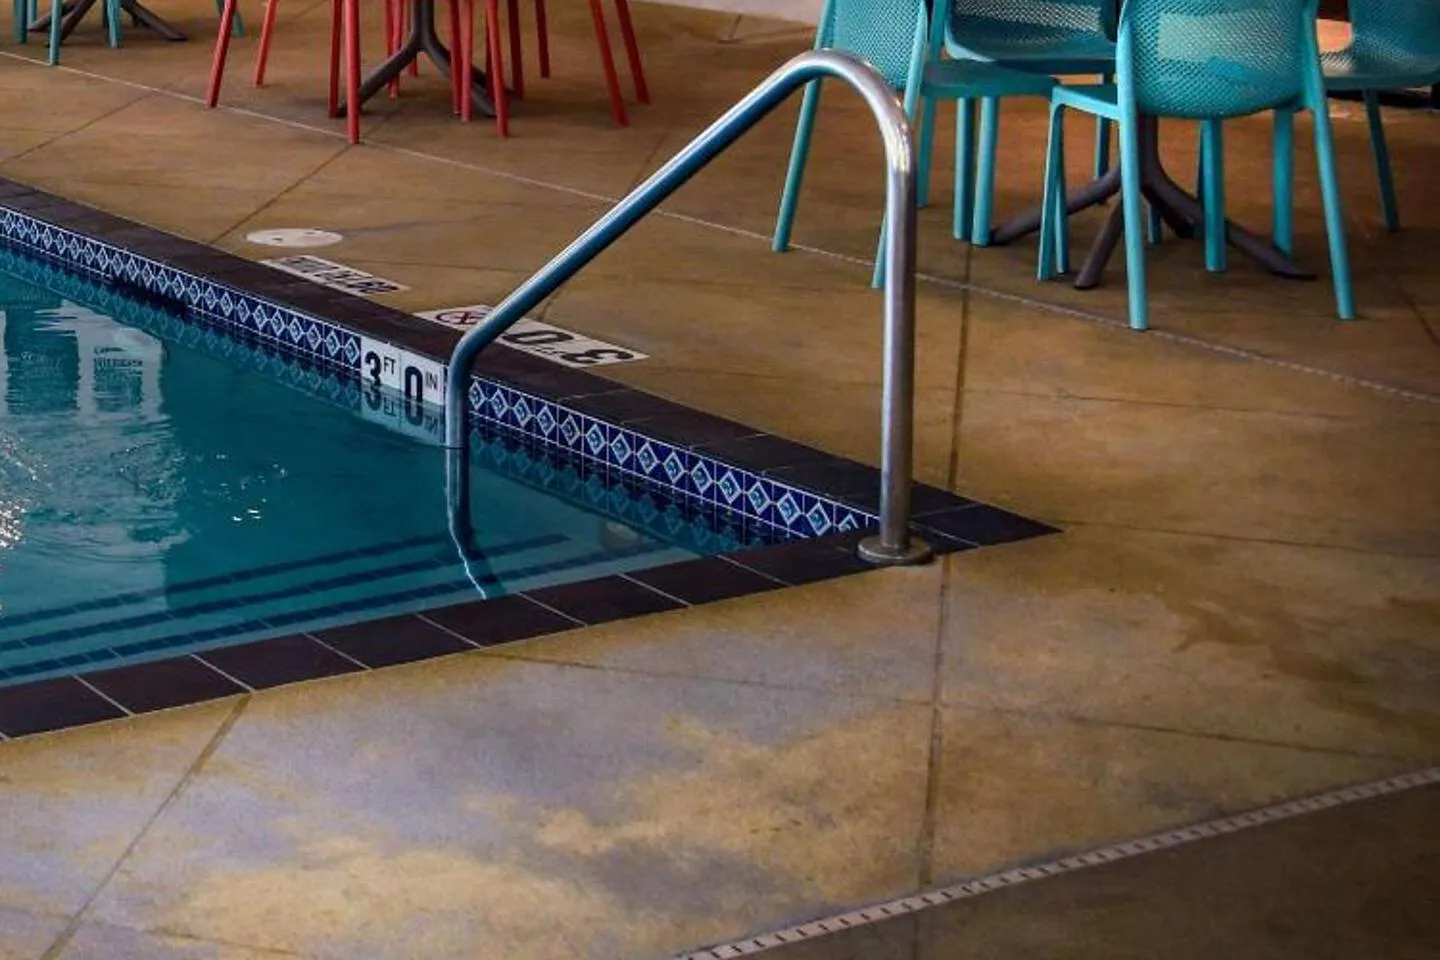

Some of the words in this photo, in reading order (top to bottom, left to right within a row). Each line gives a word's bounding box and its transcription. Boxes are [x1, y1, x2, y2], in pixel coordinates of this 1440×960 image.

[365, 351, 381, 386] 3
[383, 356, 396, 375] FT
[405, 366, 423, 402] 0
[426, 371, 438, 390] IN
